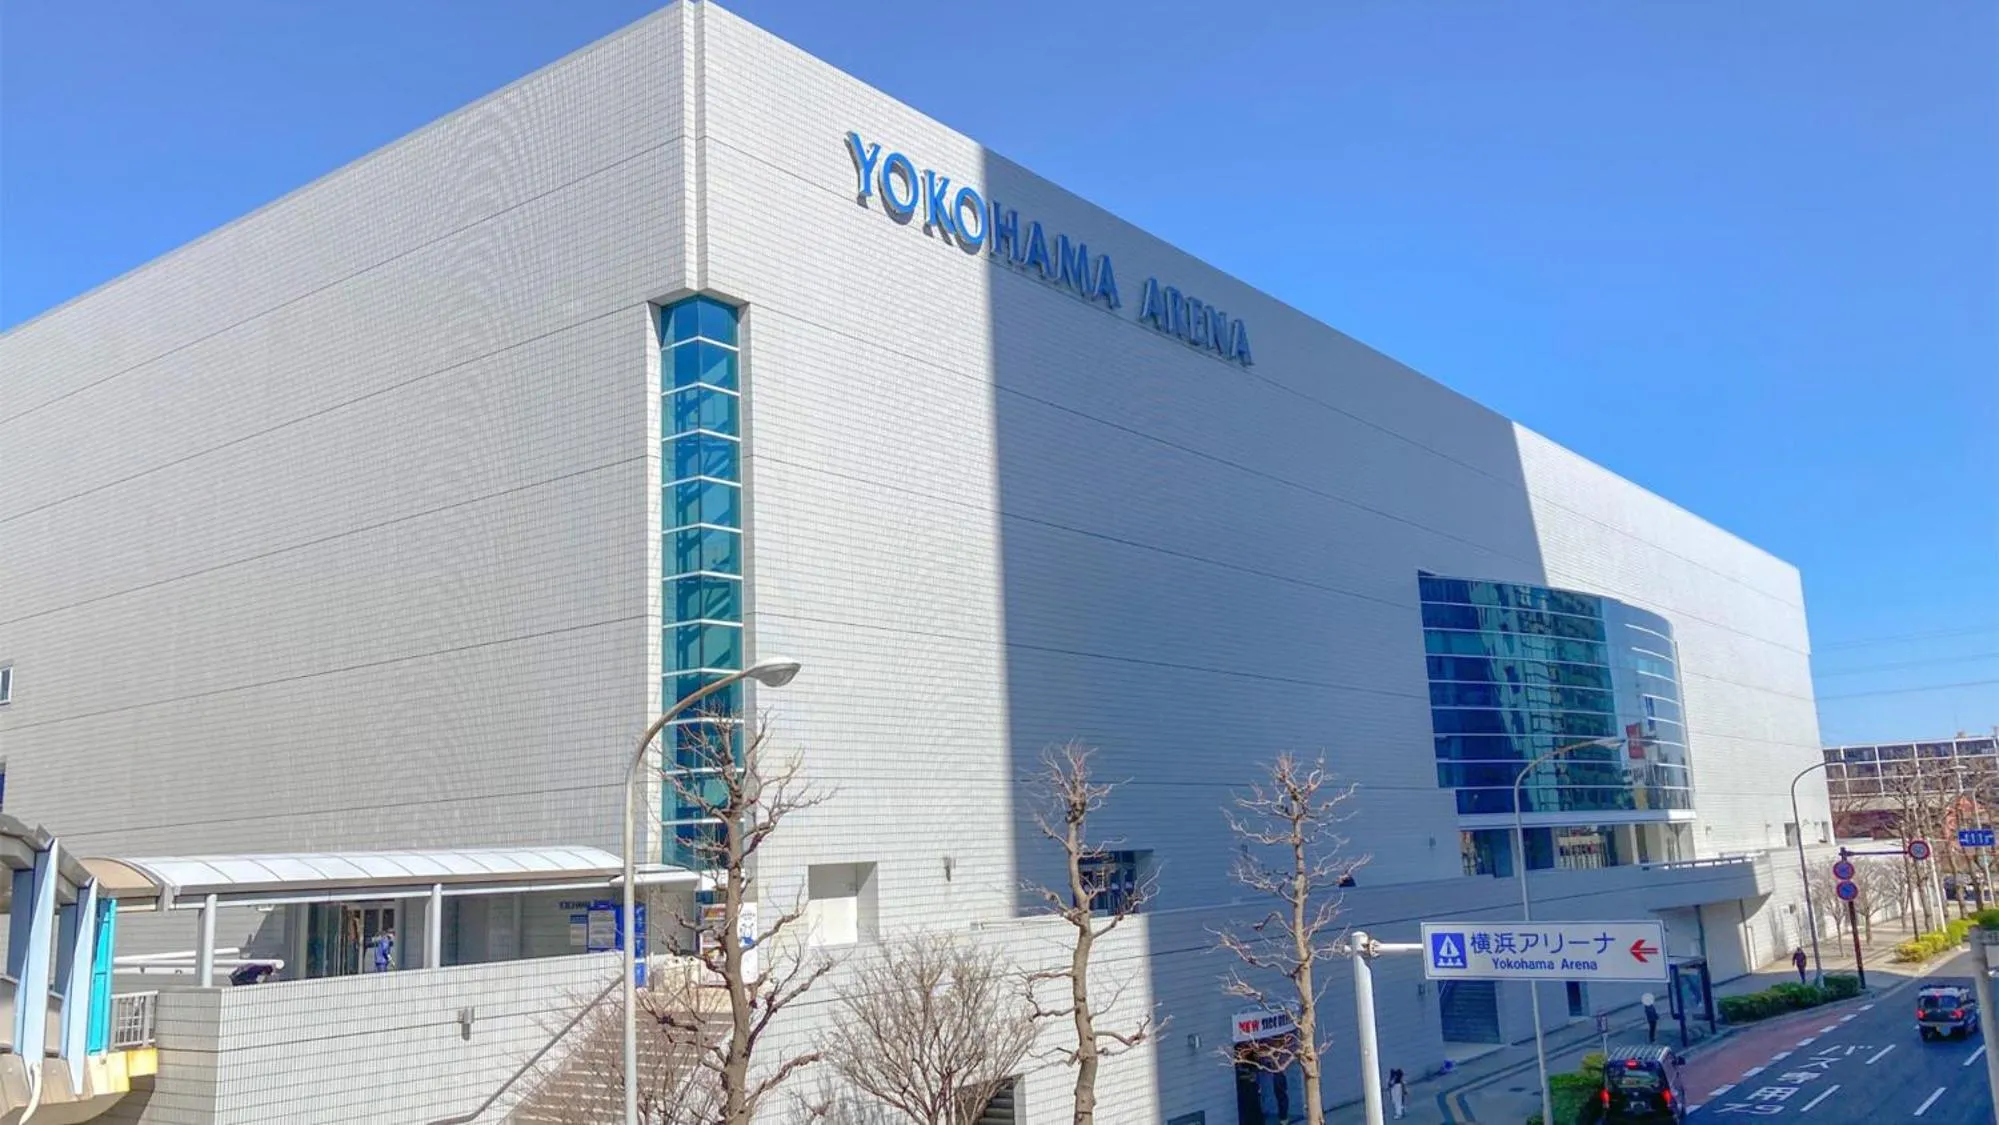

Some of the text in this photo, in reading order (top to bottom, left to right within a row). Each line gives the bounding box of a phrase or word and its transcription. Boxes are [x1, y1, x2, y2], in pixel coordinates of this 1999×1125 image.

[846, 131, 1254, 366] YOKOHAMA ARENA
[1470, 931, 1616, 954] 横浜アリーナ
[1492, 957, 1598, 971] Yokohama Arena
